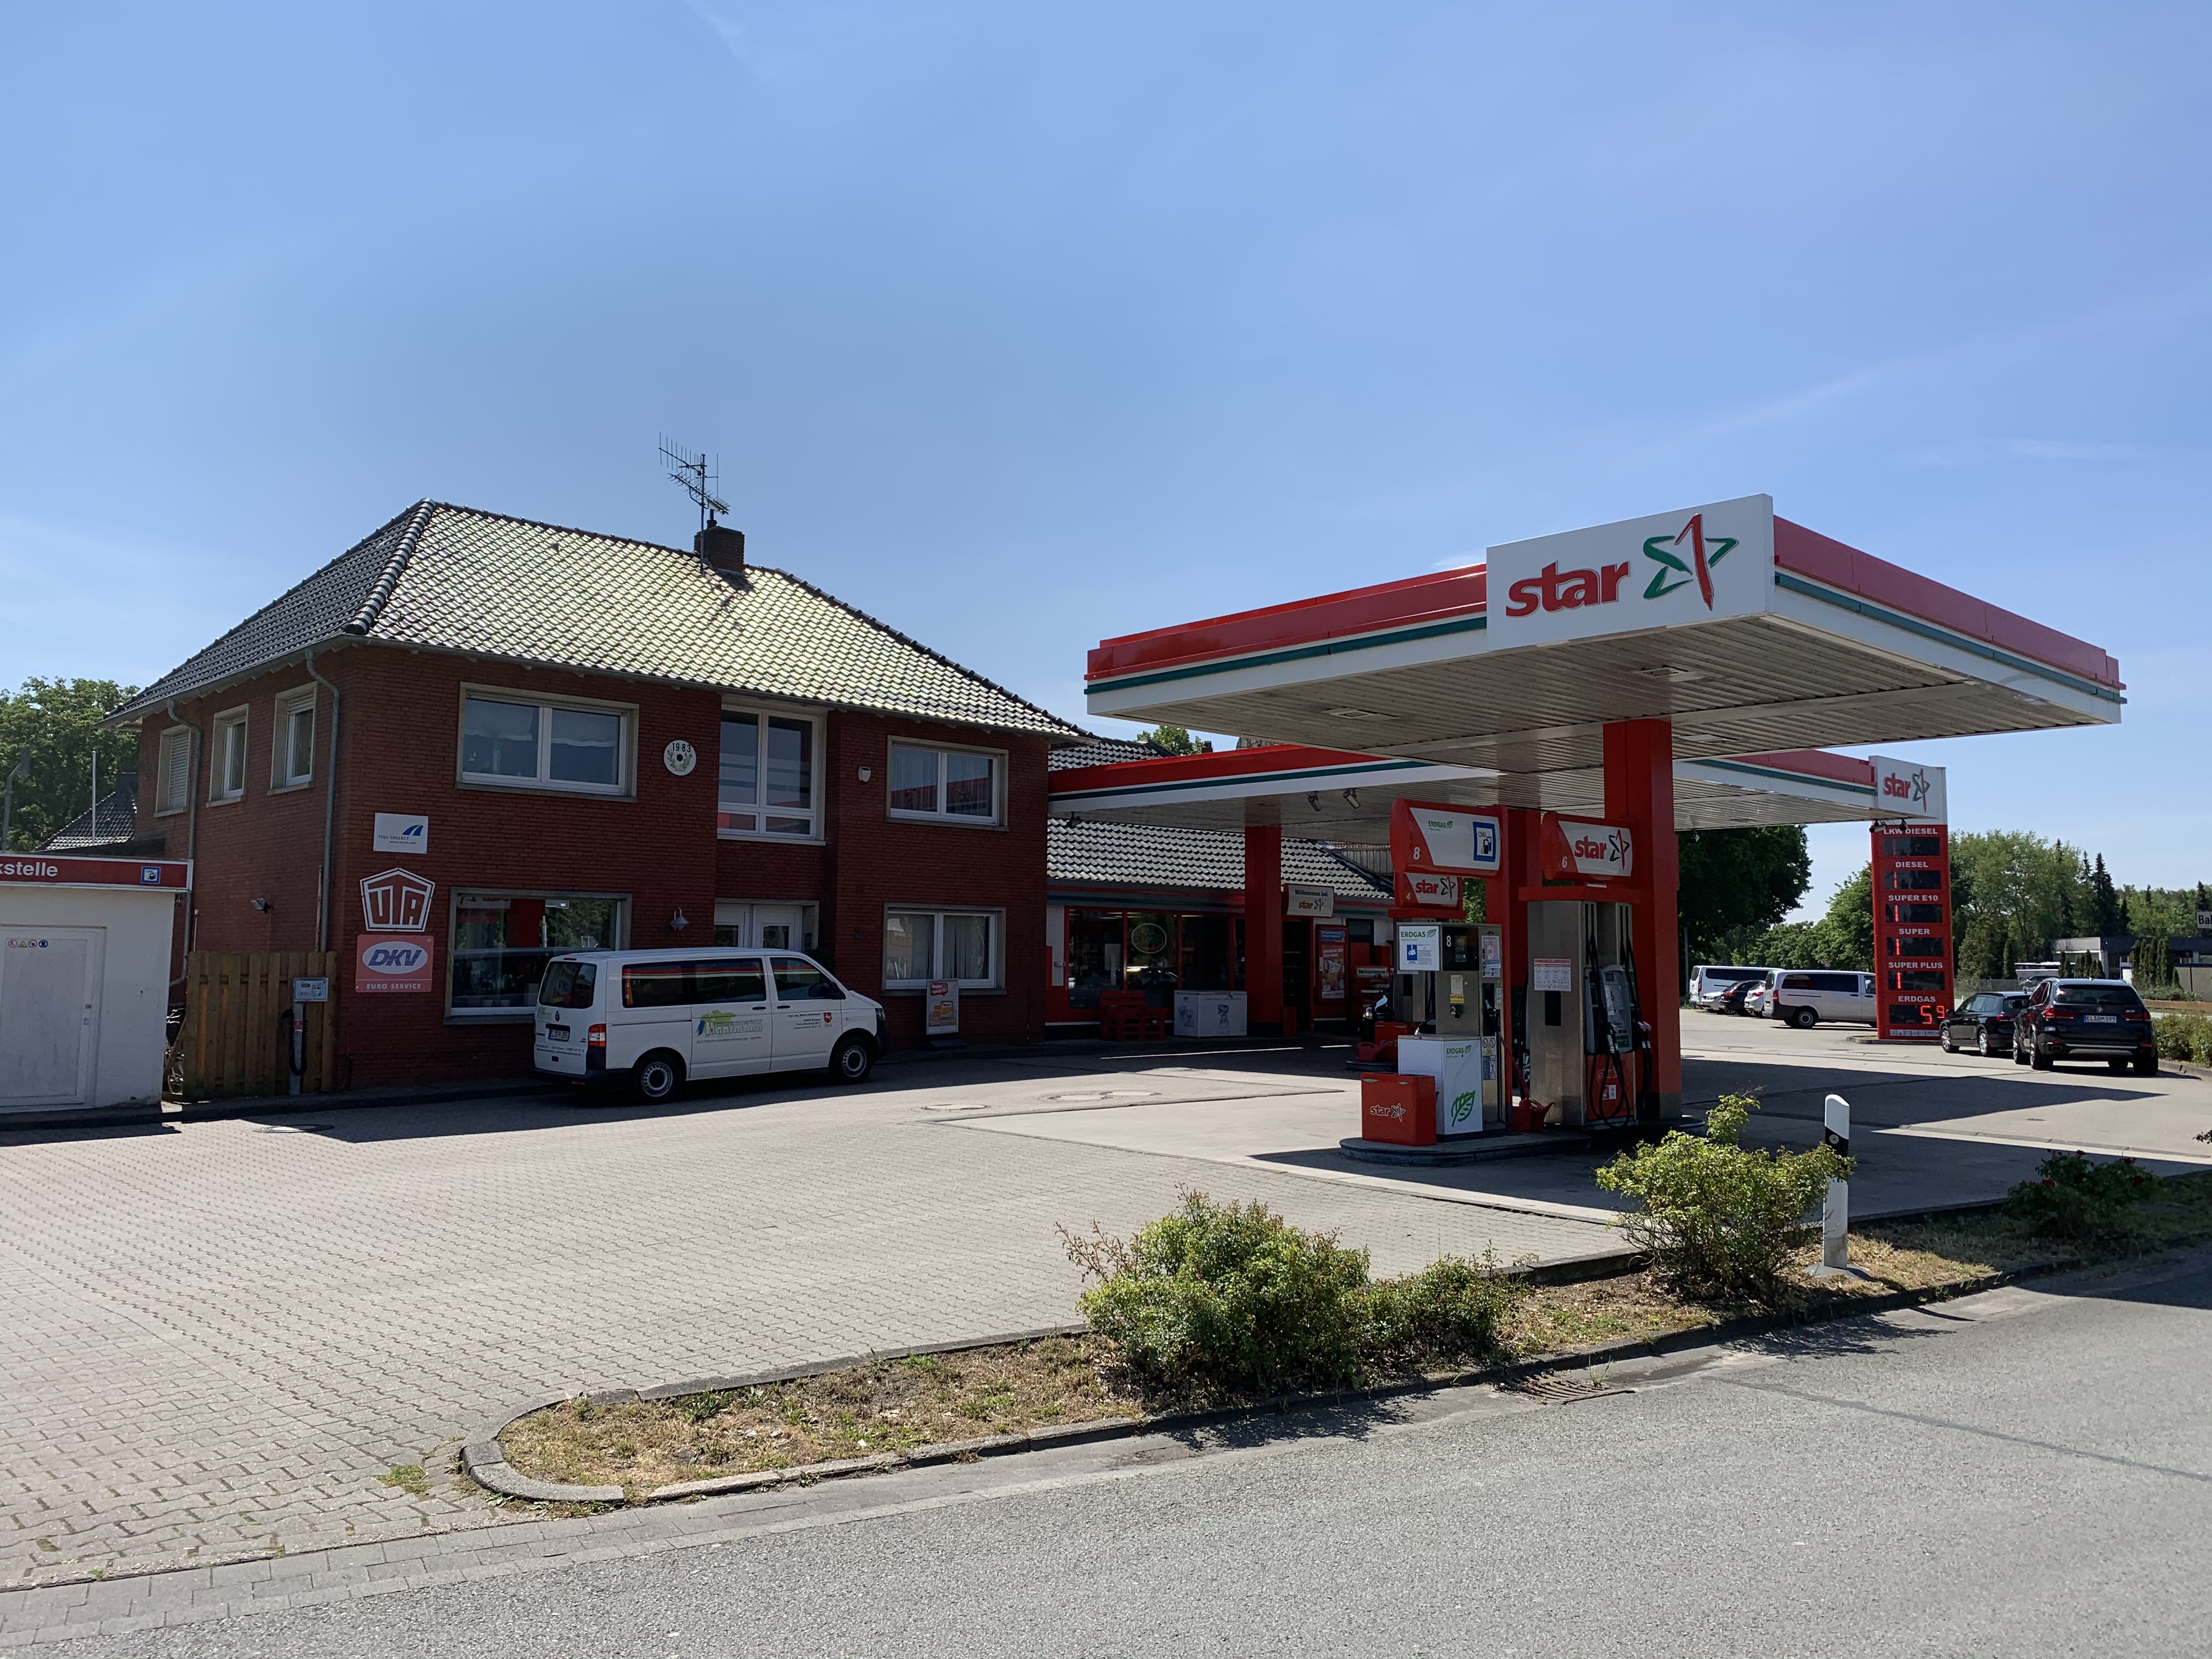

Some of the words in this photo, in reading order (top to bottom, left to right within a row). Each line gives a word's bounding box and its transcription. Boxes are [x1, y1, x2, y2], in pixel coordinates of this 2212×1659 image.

[1505, 559, 1630, 618] star
[1883, 772, 1911, 799] star
[1413, 847, 1420, 860] 8
[1574, 835, 1607, 860] star
[1562, 856, 1567, 868] 6
[1415, 879, 1439, 894] star
[368, 874, 427, 925] UTA
[1406, 892, 1411, 900] 4
[1298, 900, 1313, 909] star
[1446, 935, 1452, 947] 8
[368, 949, 422, 966] DKV
[706, 1022, 763, 1036] Haarmann
[1370, 1104, 1391, 1117] star
